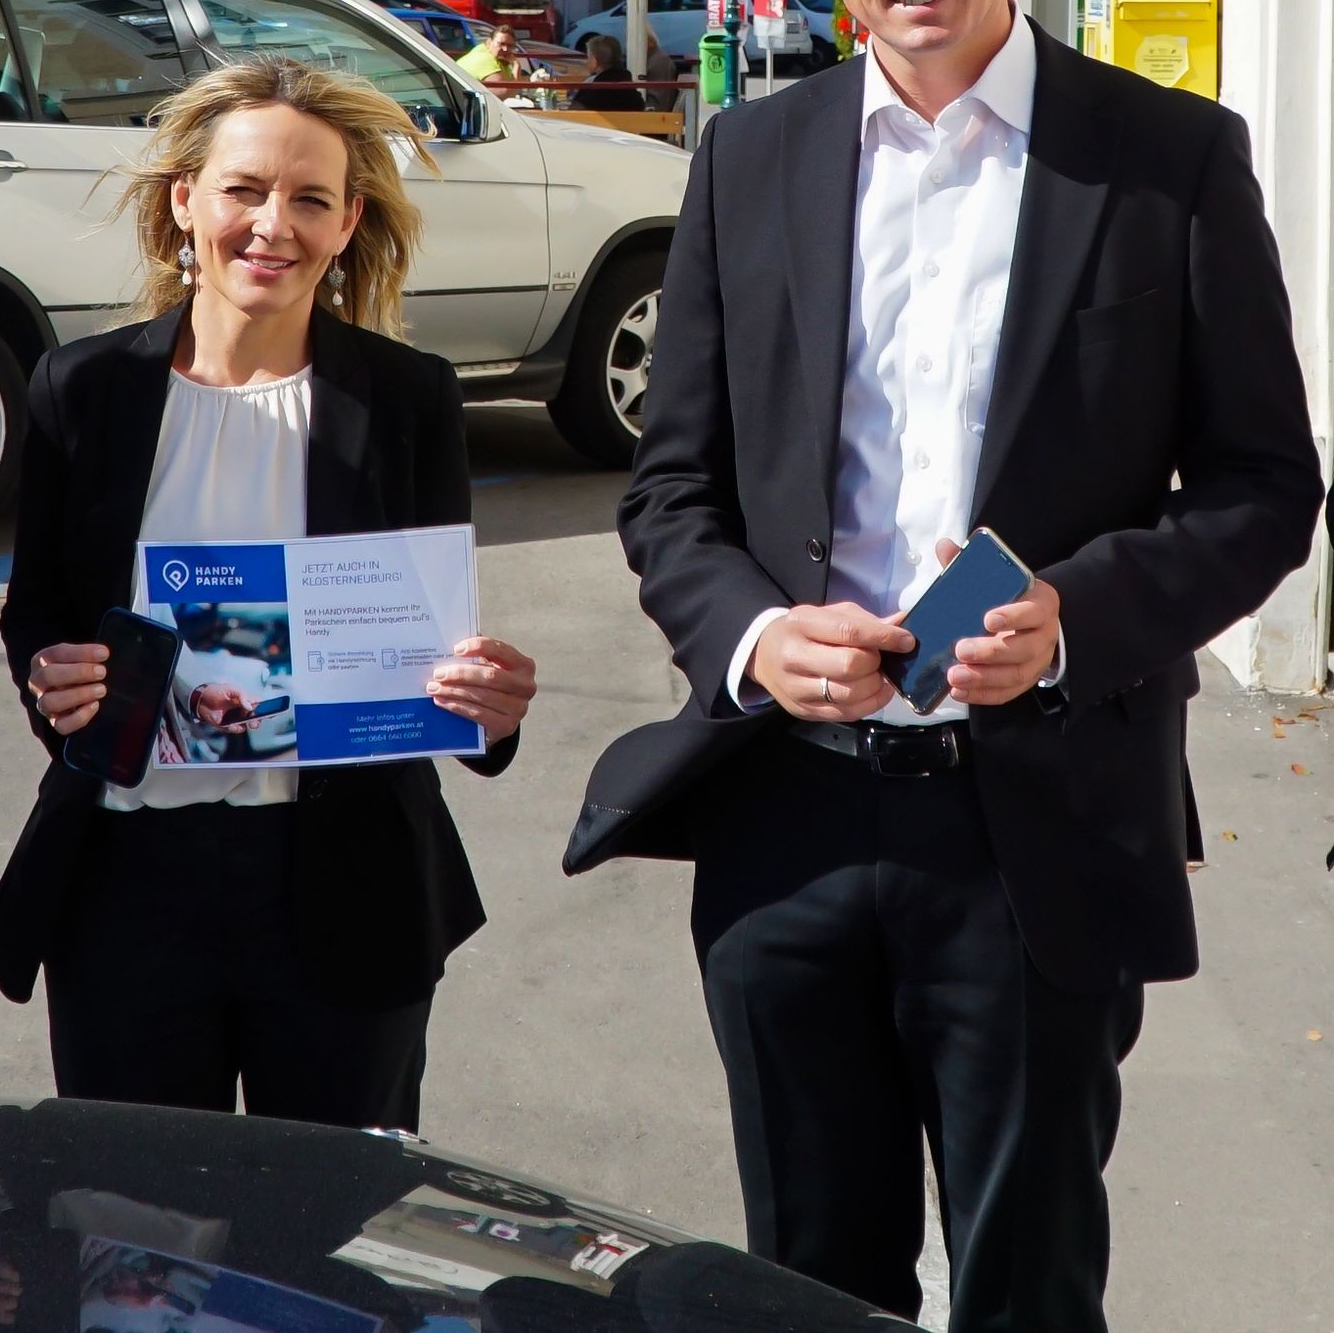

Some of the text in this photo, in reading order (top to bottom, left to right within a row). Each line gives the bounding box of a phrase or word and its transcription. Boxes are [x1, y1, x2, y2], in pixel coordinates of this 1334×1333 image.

[195, 565, 236, 576] HANDY
[301, 560, 380, 574] JETZT AUCH IN
[195, 575, 243, 586] PARKEN
[301, 572, 403, 587] KLOSTERNEUBURG!
[304, 608, 317, 616] Mit
[318, 606, 380, 616] HANDYPARKEN
[381, 605, 409, 613] kommt
[304, 617, 347, 626] Parkschein
[348, 616, 377, 625] einfach
[378, 615, 411, 624] bequem
